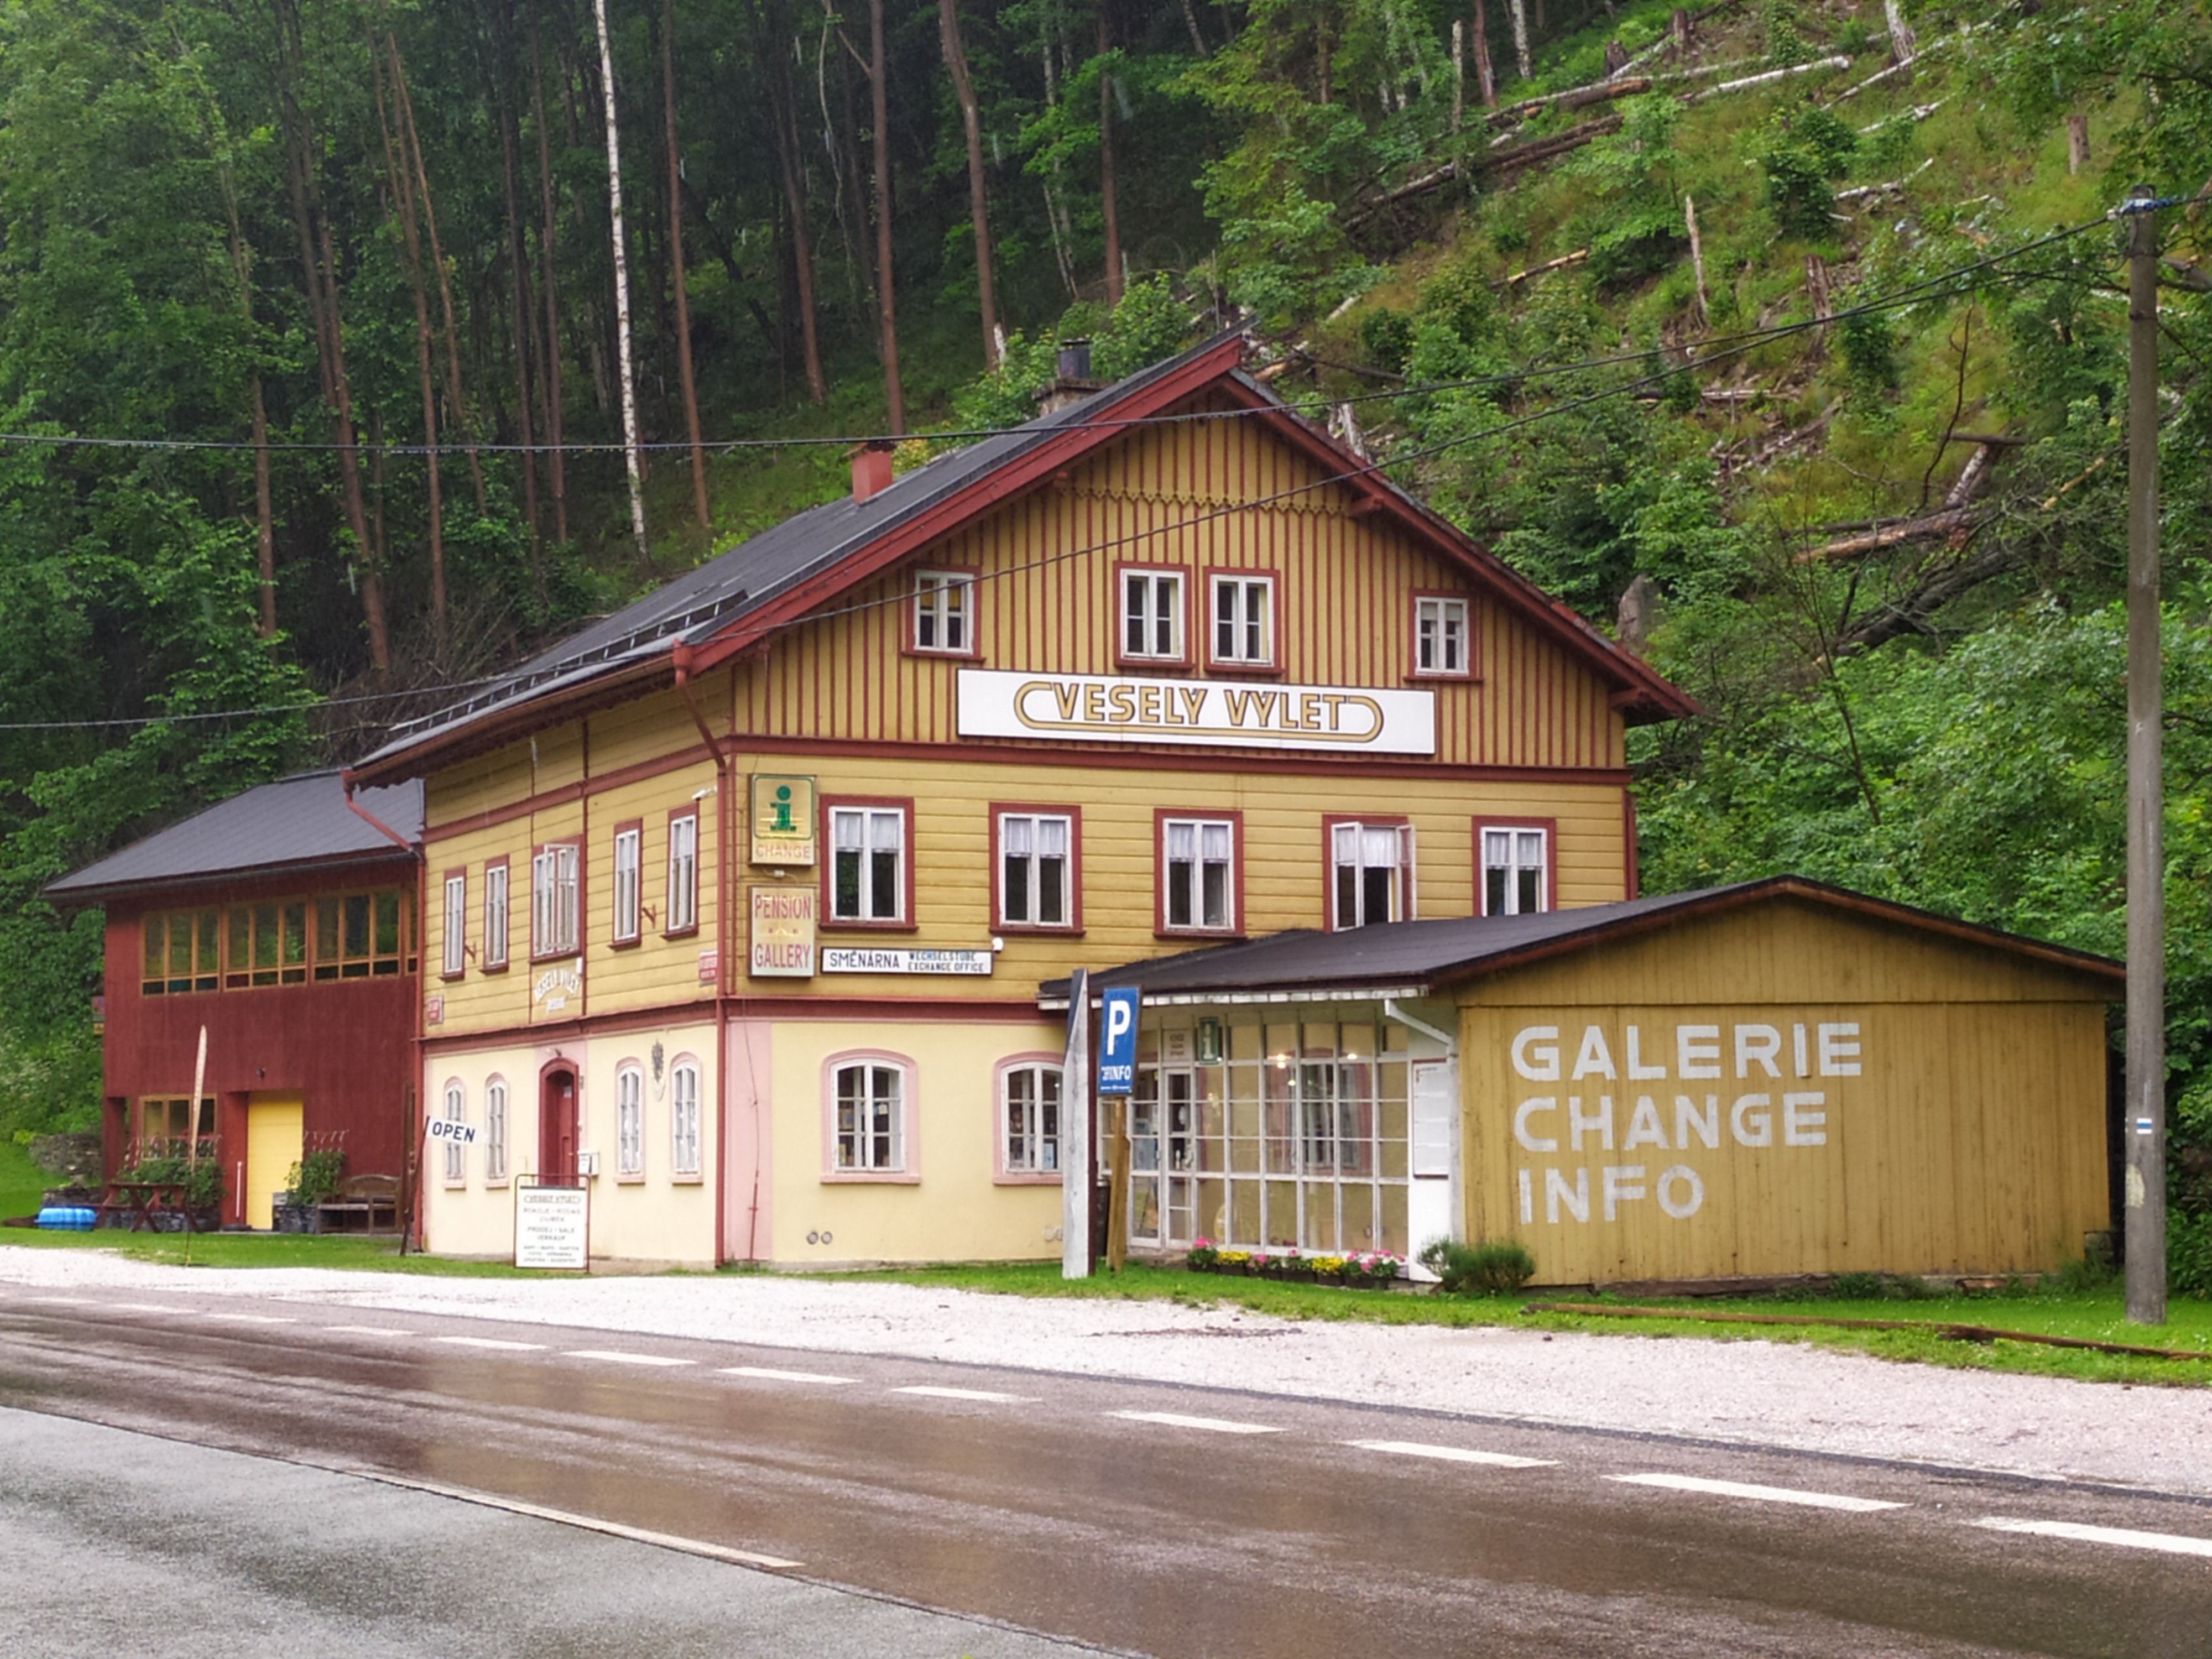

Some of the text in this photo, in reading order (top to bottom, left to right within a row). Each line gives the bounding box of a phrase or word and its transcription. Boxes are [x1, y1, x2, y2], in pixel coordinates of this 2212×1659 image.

[756, 844, 810, 859] CHANGE
[755, 895, 811, 919] PENSION
[754, 945, 810, 968] GALLERY
[953, 963, 984, 972] OFFICE
[1107, 1000, 1131, 1056] P
[1511, 1023, 1861, 1081] GALERIE
[432, 1121, 475, 1143] OPEN
[1514, 1091, 1826, 1152] CHANGE
[1518, 1164, 1704, 1224] INFO
